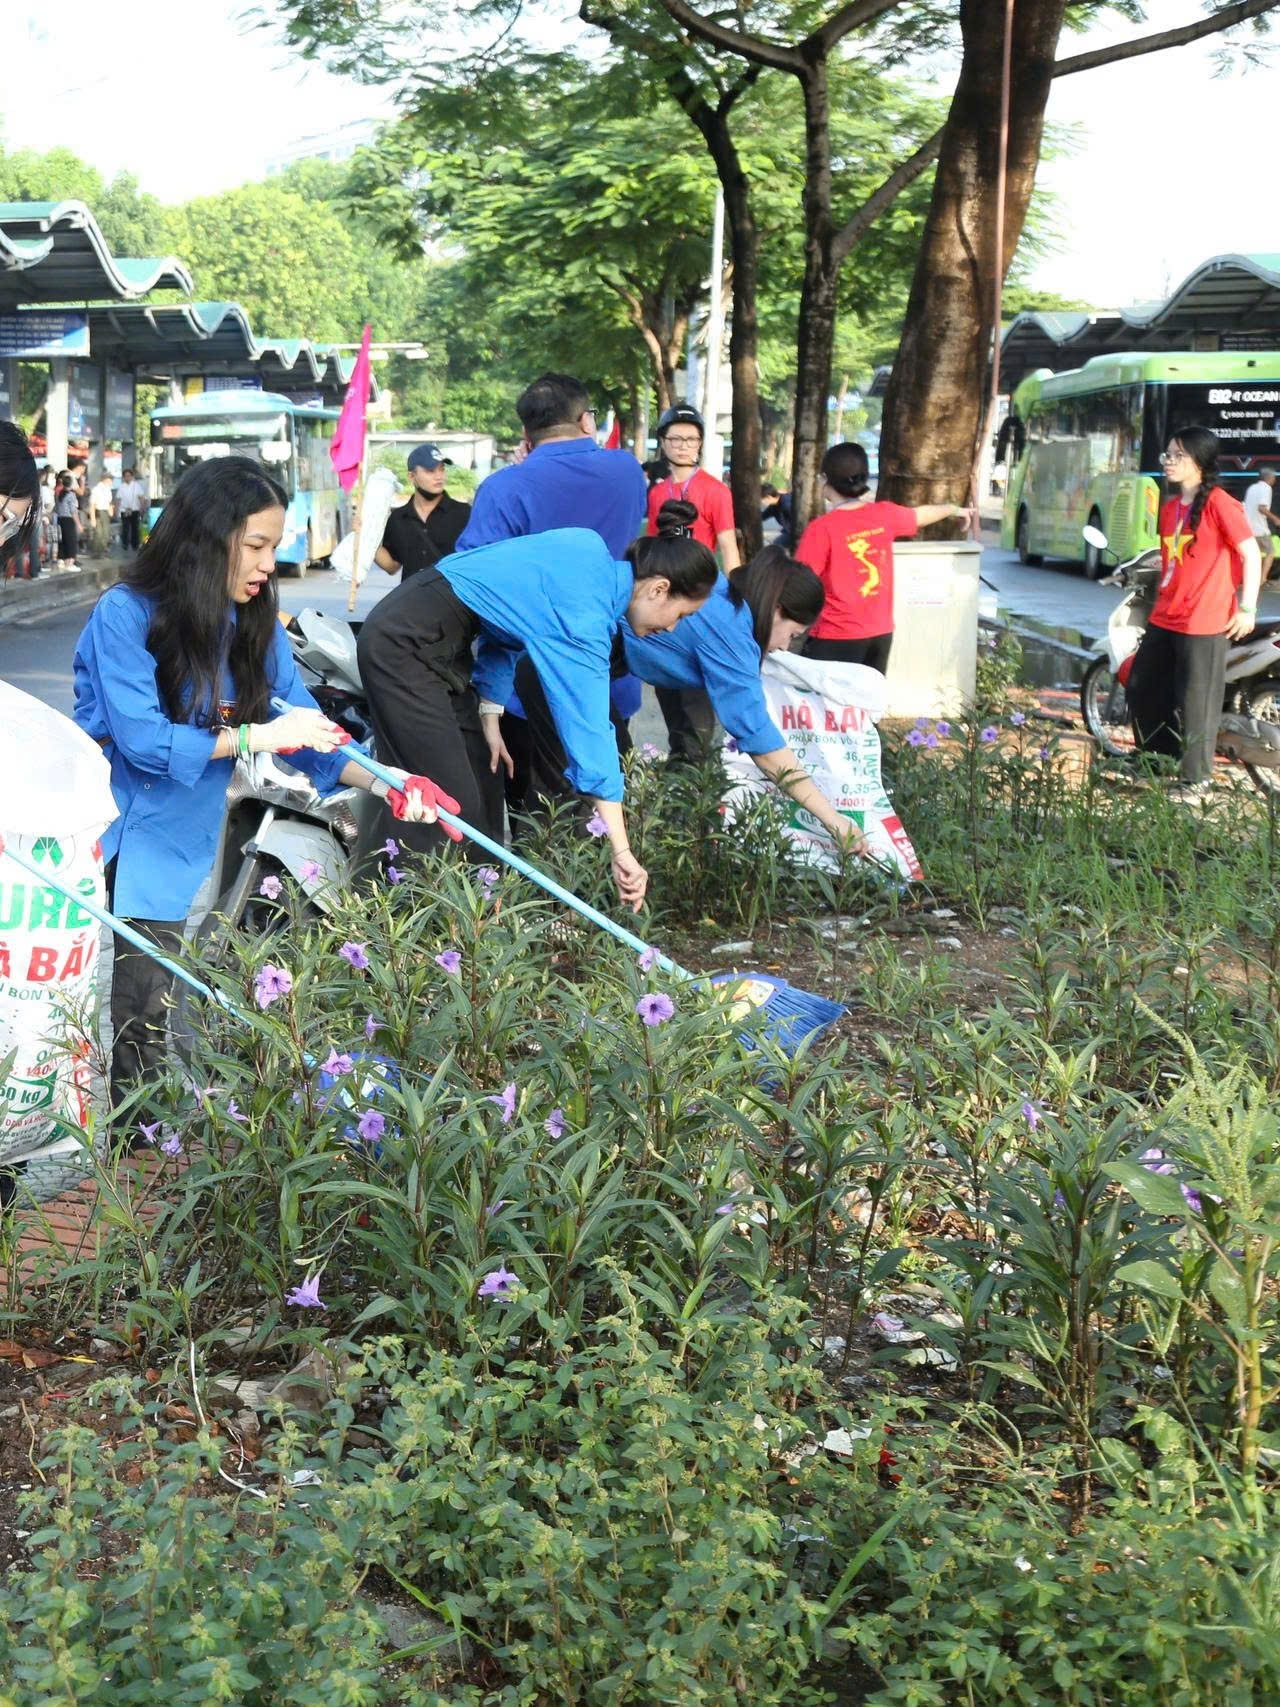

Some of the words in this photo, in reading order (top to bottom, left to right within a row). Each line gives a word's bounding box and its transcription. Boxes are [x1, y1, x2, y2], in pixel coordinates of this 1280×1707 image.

[1242, 391, 1279, 402] OCEAN
[781, 701, 814, 730] HÀ
[20, 1089, 41, 1105] kg
